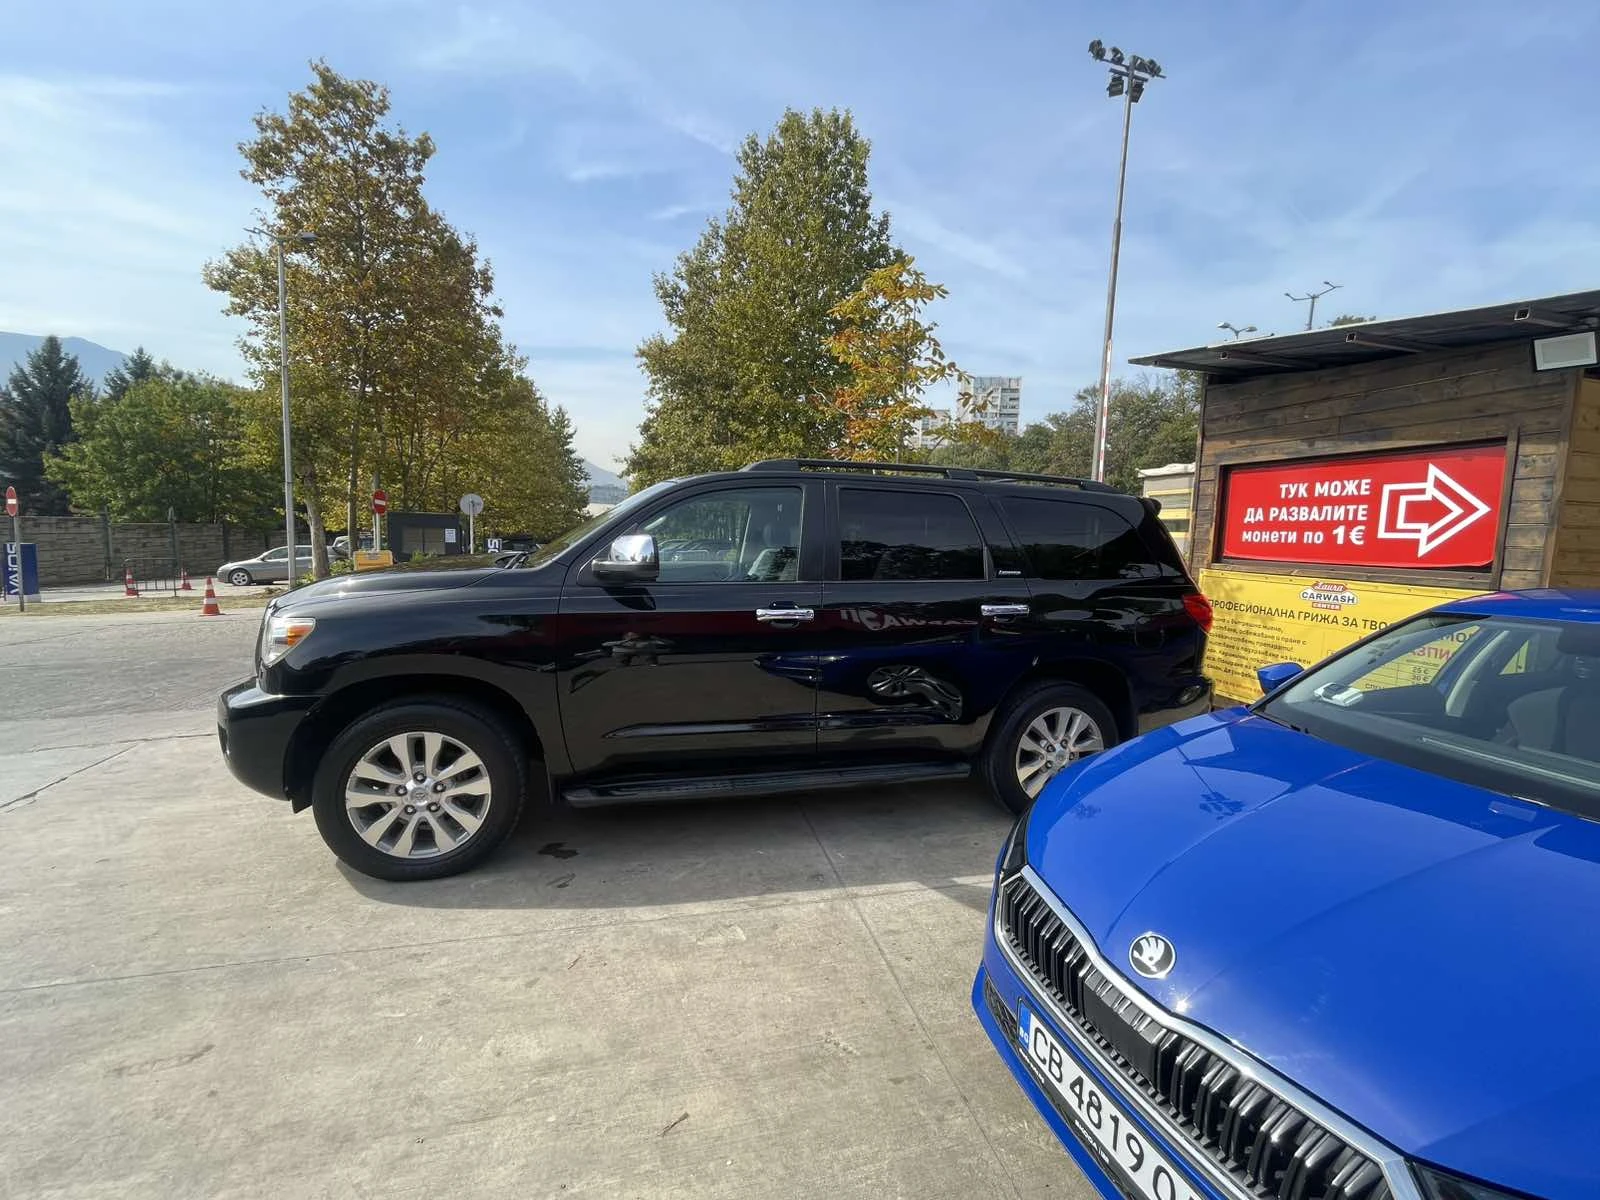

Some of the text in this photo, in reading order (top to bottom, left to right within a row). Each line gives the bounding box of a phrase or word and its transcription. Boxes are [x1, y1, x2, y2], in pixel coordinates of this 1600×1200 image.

[1280, 479, 1371, 499] ТУК МОЖЕ
[1244, 504, 1368, 524] ДА РАЗВАЛИТЕ
[1242, 530, 1297, 543] монети
[1303, 531, 1324, 544] по
[1314, 581, 1344, 592] Laura
[1302, 591, 1355, 604] CARWASH
[1298, 611, 1339, 625] ГРИЖА
[1342, 616, 1358, 628] ЗА
[1033, 1027, 1063, 1084] CB
[1069, 1076, 1145, 1173] 4819
